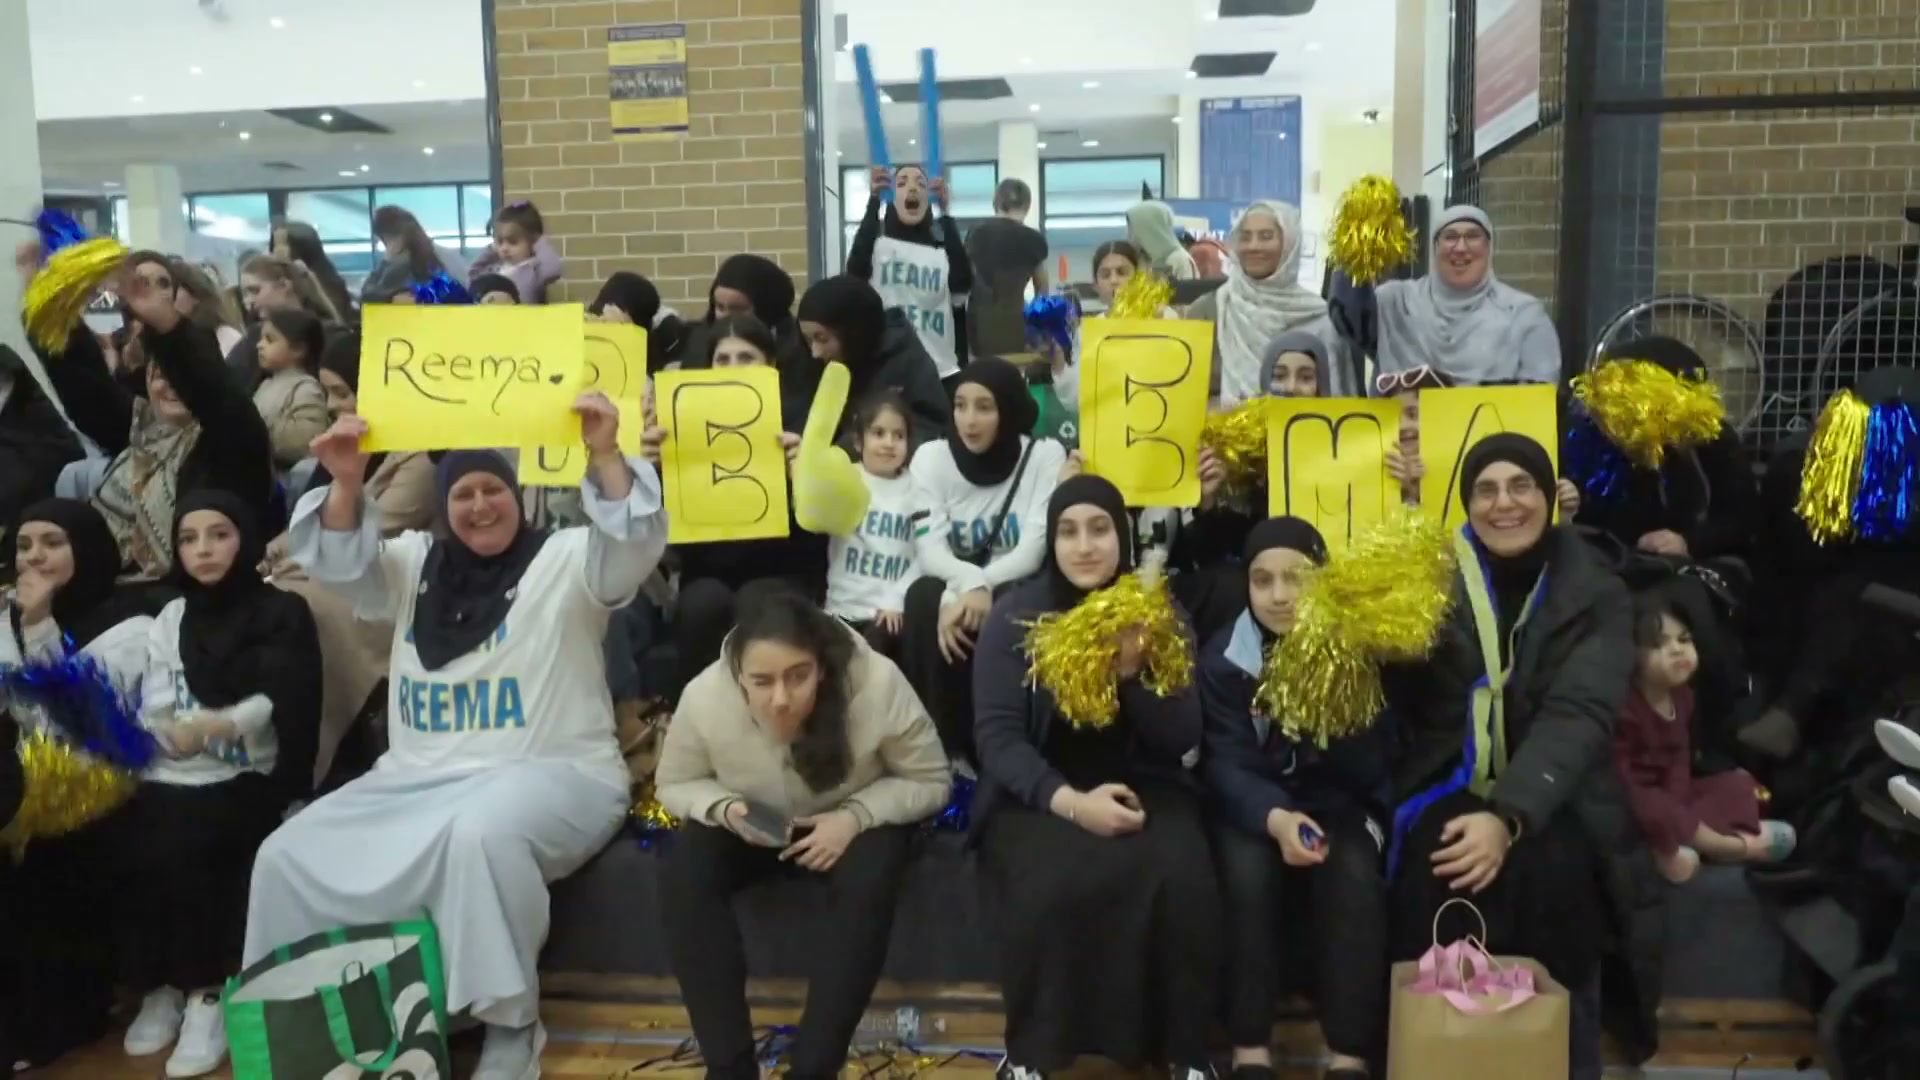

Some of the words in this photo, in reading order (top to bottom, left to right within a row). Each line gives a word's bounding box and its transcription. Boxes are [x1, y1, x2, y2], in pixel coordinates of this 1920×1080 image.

[879, 260, 942, 293] TEAM
[857, 510, 912, 542] EAM
[950, 511, 1020, 551] EAM
[398, 674, 526, 733] REEMA
